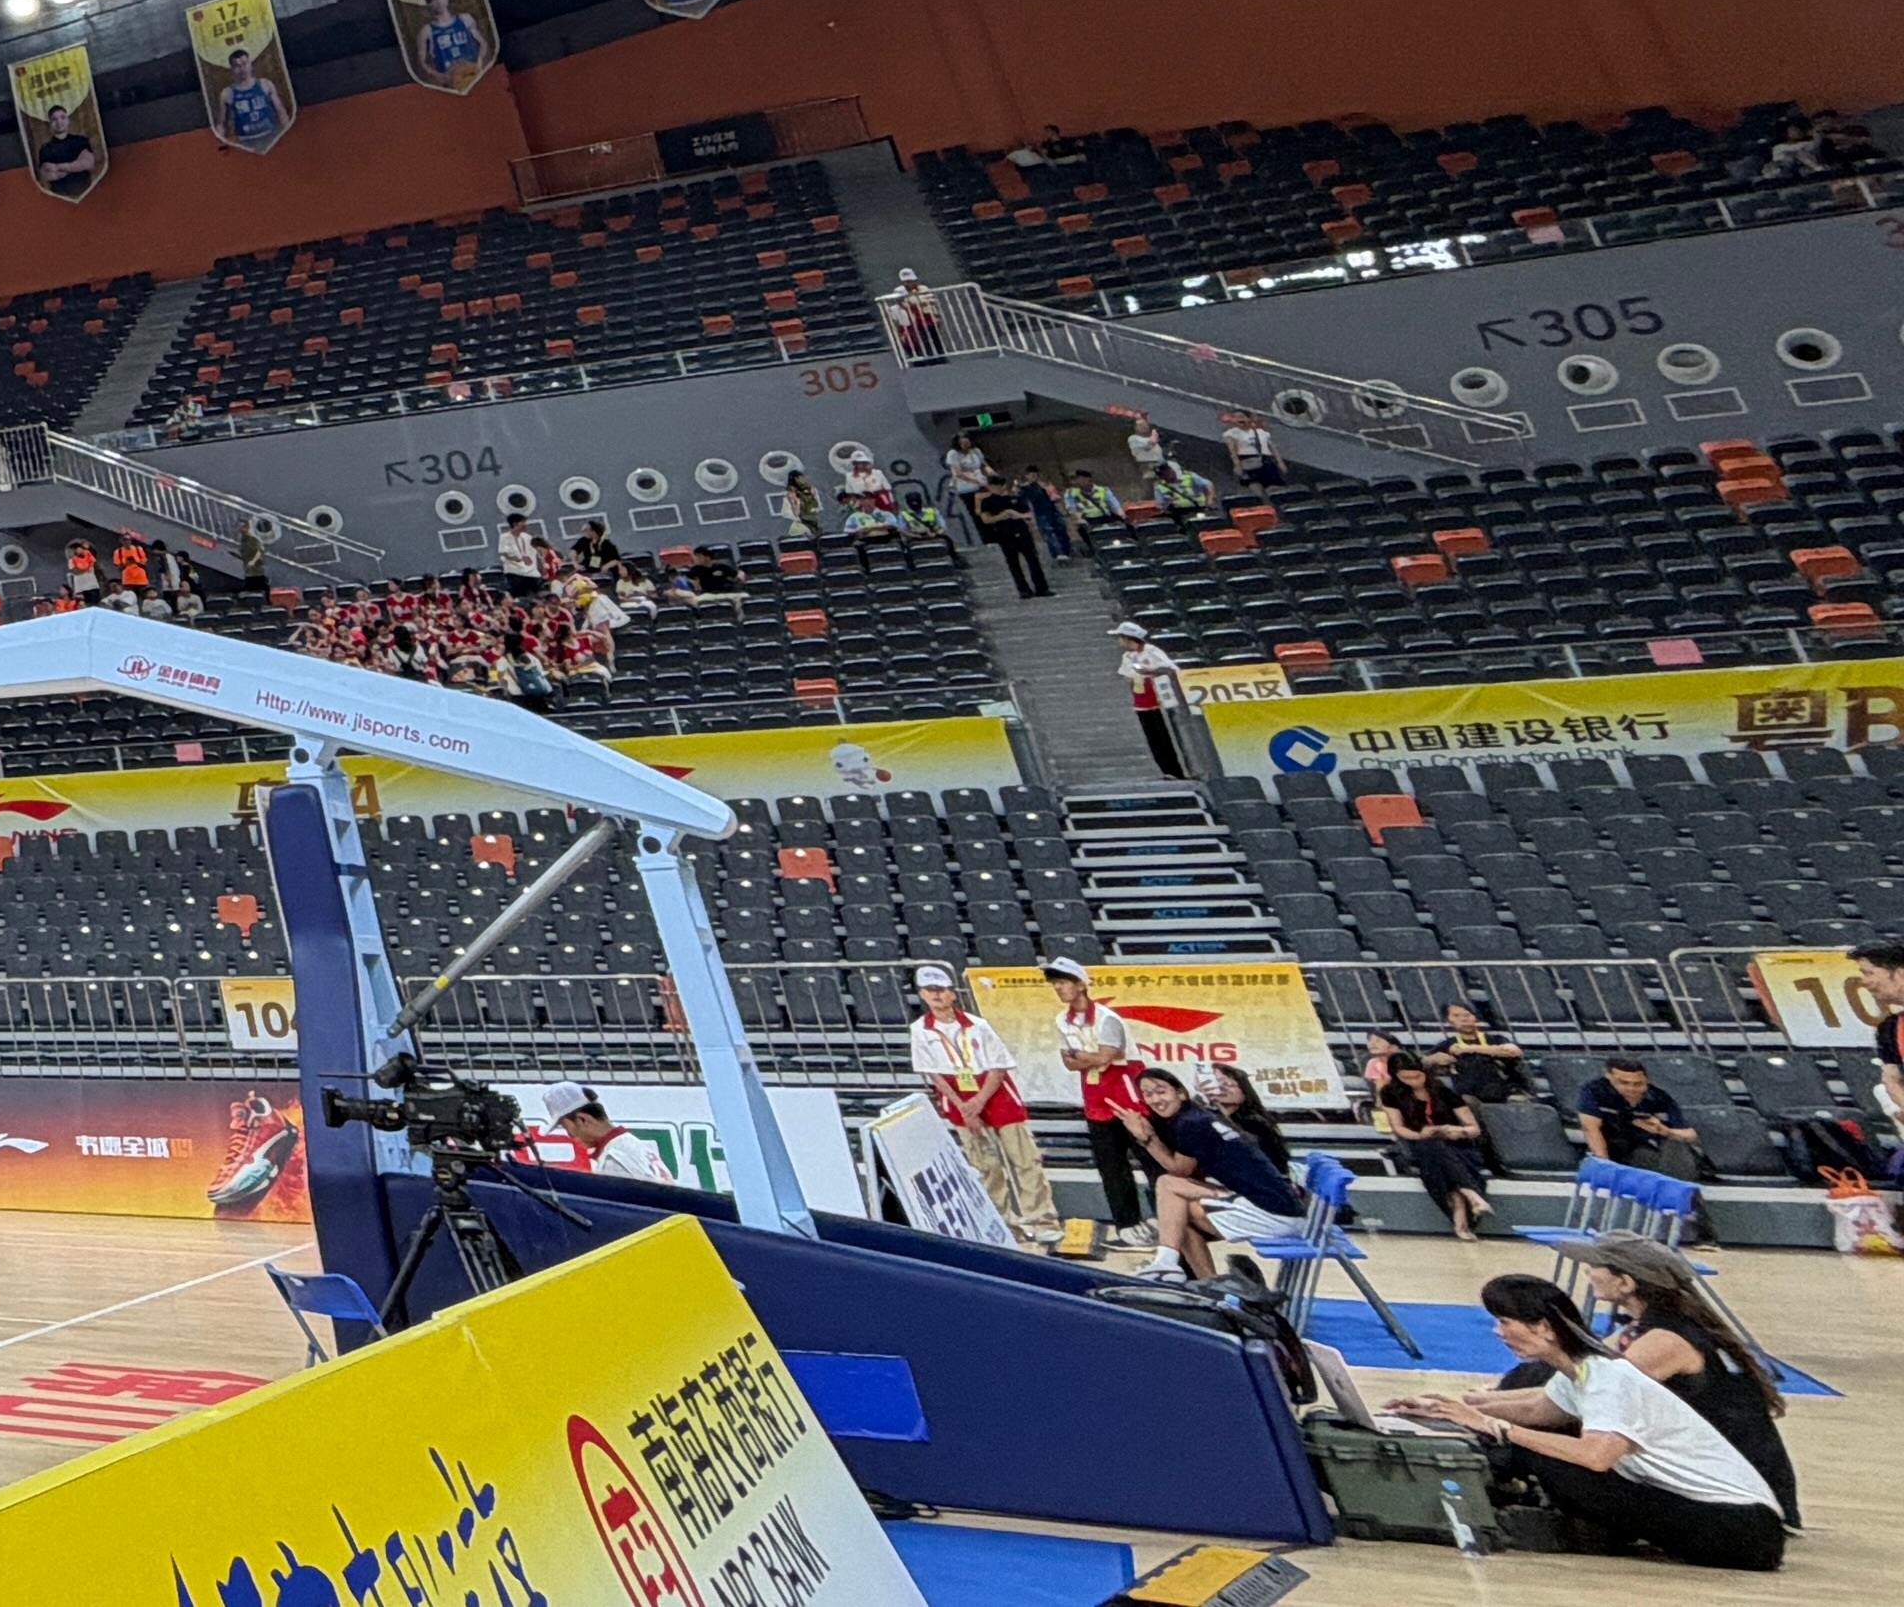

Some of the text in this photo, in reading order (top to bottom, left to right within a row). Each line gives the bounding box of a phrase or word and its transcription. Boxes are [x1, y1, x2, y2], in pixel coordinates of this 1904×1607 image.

[1527, 295, 1664, 349] 305
[799, 362, 879, 397] 305
[419, 446, 502, 485] 304
[1348, 711, 1670, 751] 中国建设银行
[1138, 1042, 1237, 1062] NING
[627, 1332, 807, 1548] 南海农商银行
[768, 1494, 832, 1596] BANK
